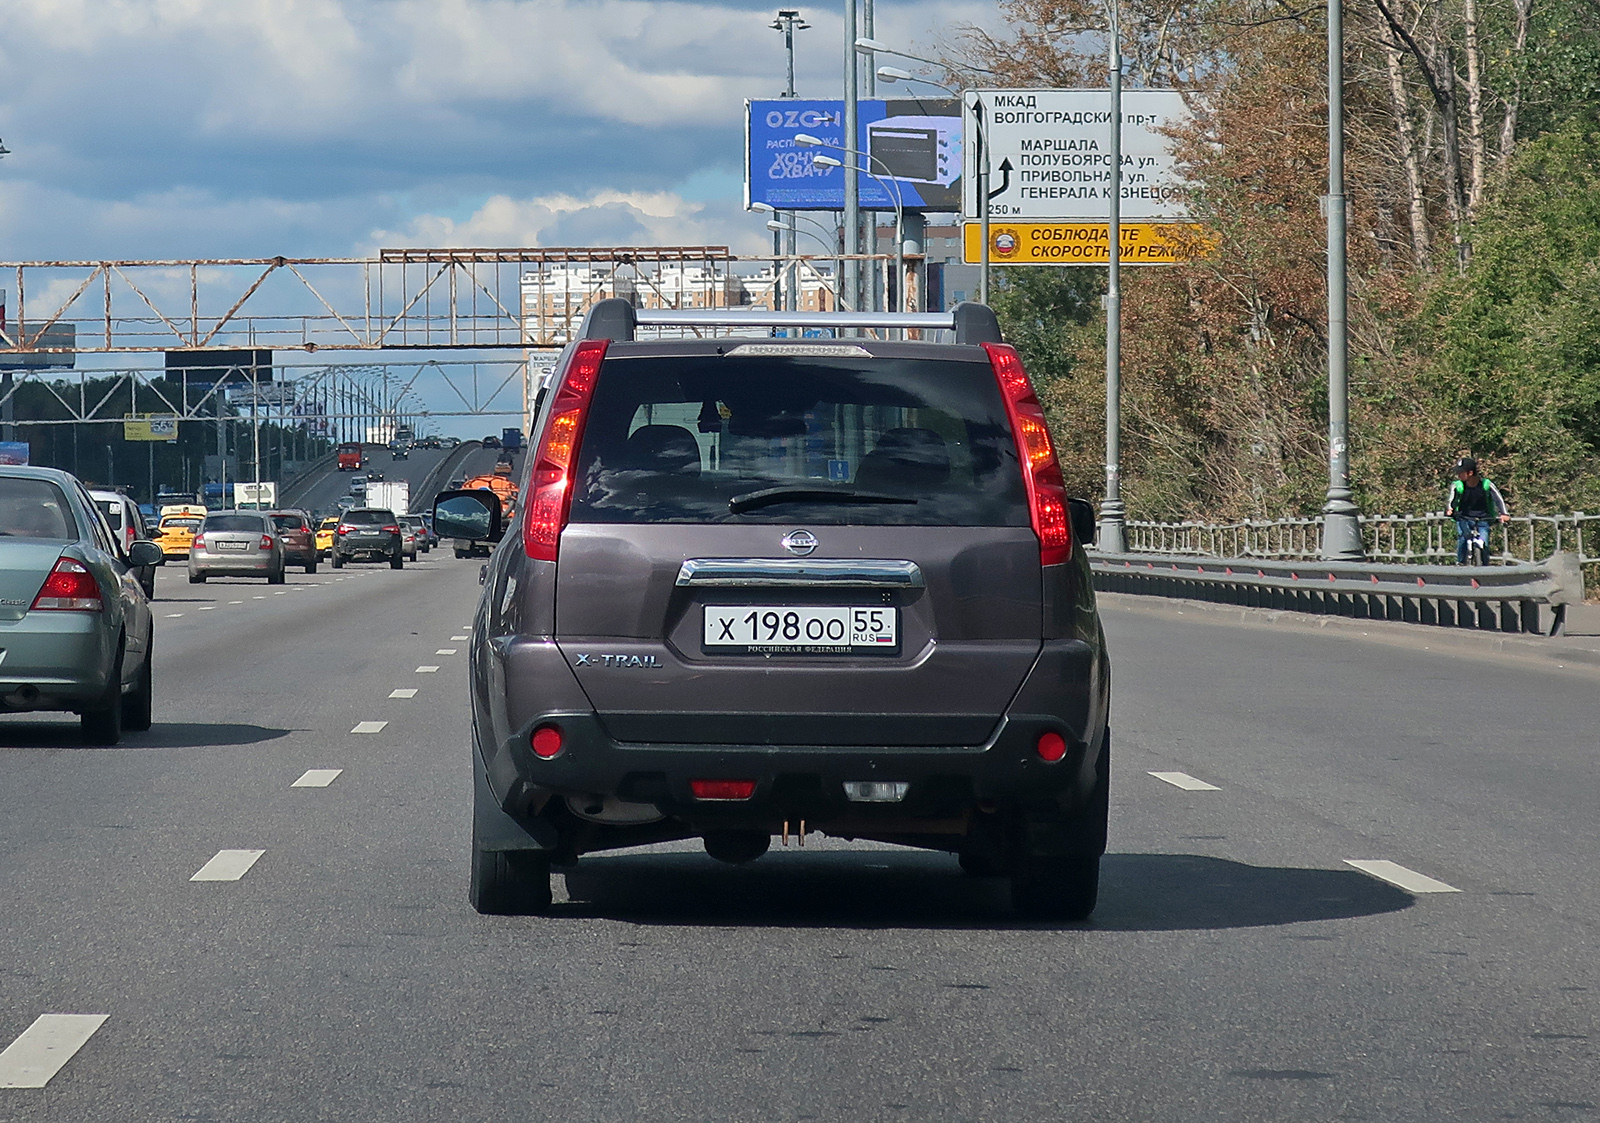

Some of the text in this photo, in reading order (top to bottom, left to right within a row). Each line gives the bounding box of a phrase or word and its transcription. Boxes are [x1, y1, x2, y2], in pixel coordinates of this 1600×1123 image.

[994, 95, 1036, 108] МКАД
[766, 110, 841, 128] OZON
[994, 112, 1157, 126] ВОЛГОГРАДСКИ пр-т
[766, 137, 839, 149] РАСПЖА
[1021, 139, 1099, 151] МАРШАЛА
[1138, 157, 1159, 169] ул.
[1021, 170, 1124, 182] ПРИВОЛЬНА
[1021, 187, 1099, 199] ГЕНЕРАЛА
[988, 204, 1009, 215] 250
[1031, 228, 1140, 243] СОБЛЮДАТЕ
[853, 634, 875, 642] RUS
[575, 653, 664, 668] X-TRAIL
